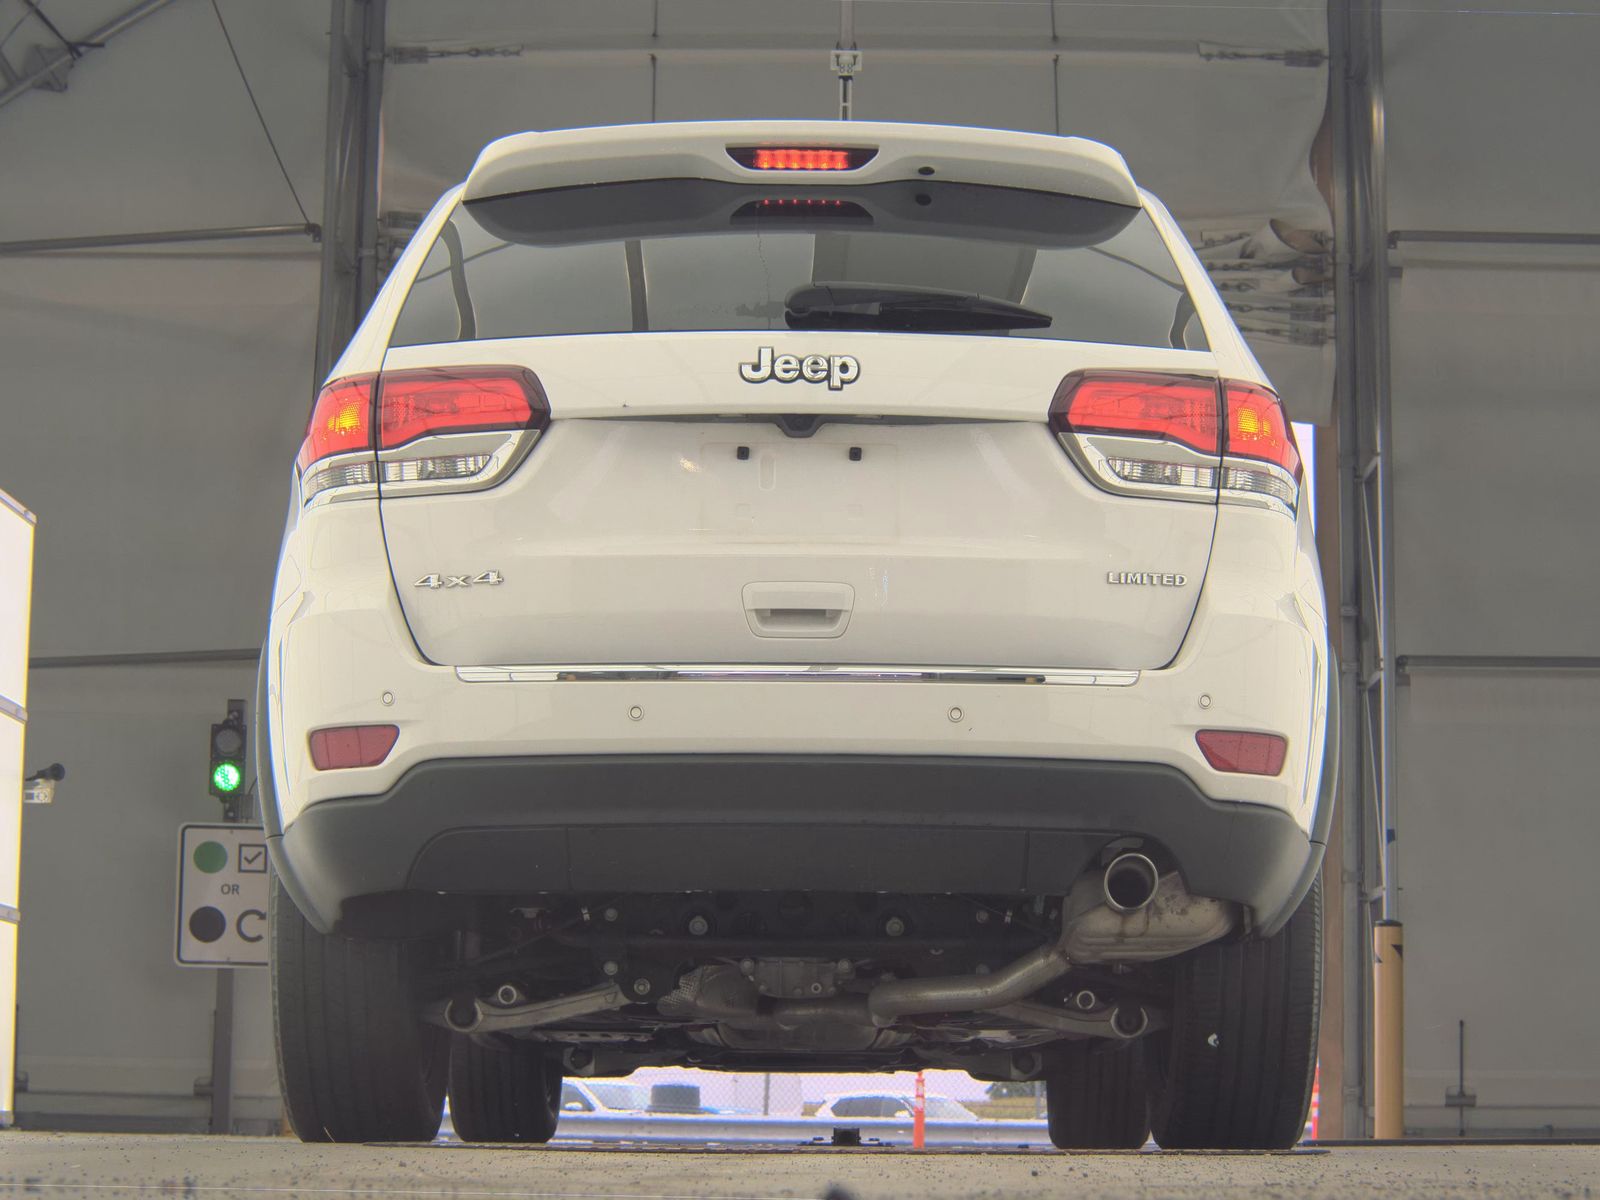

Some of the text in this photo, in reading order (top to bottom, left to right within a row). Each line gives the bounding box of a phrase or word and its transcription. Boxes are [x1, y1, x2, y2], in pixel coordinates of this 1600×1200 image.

[739, 346, 860, 391] Jeep
[414, 570, 504, 588] 4x4
[1107, 571, 1188, 587] LIMITED
[221, 883, 240, 895] OR
